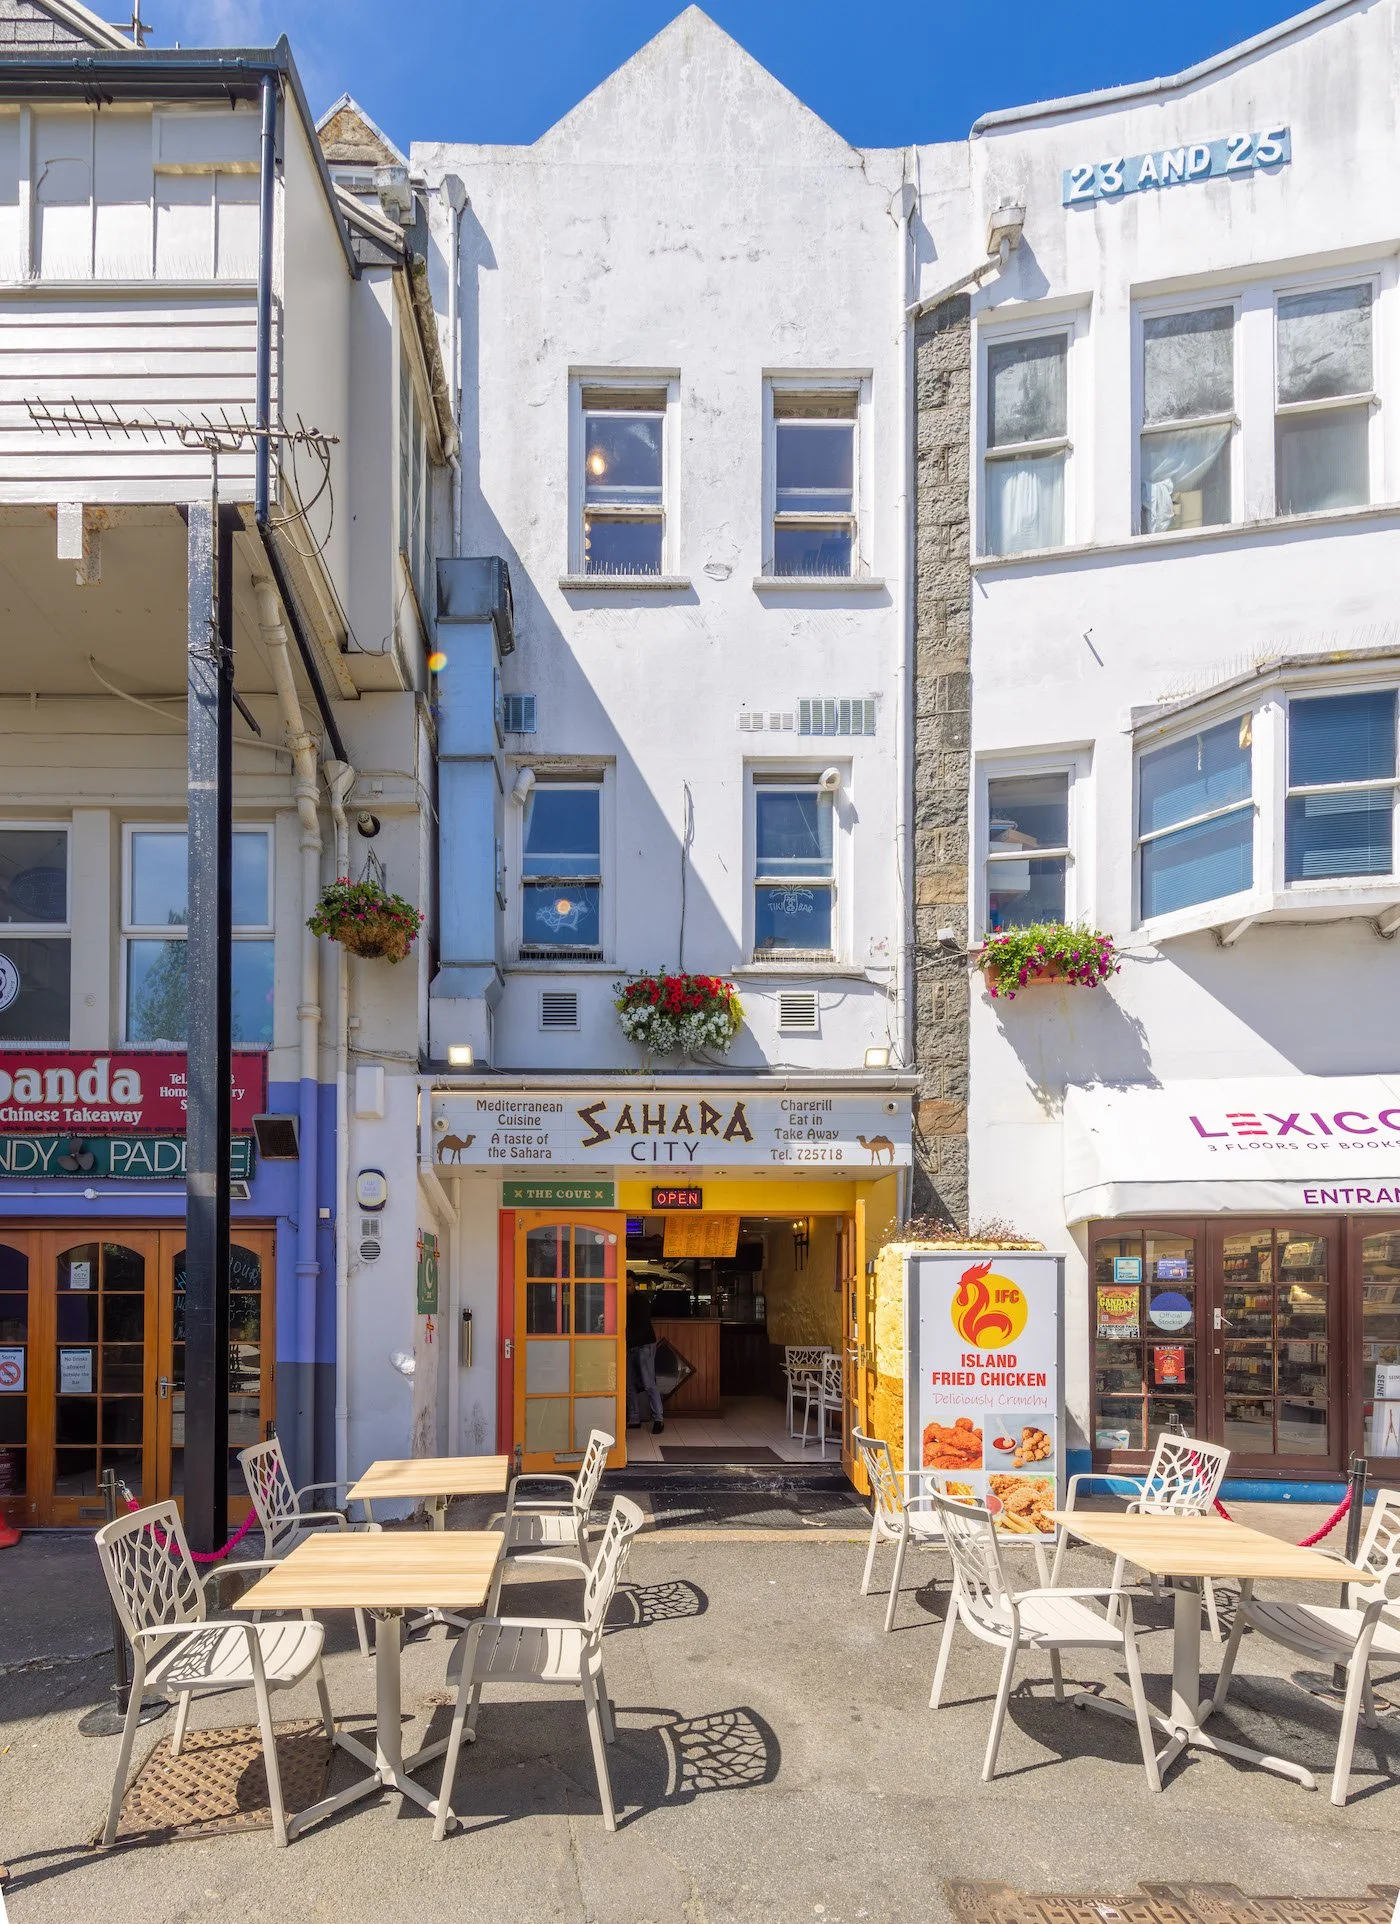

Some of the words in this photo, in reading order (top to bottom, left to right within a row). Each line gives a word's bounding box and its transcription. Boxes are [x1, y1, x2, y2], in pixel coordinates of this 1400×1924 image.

[1070, 155, 1125, 200] 23
[1137, 144, 1211, 187] AND
[1226, 126, 1287, 172] 25
[476, 1099, 563, 1112] Mediterranean
[780, 1099, 832, 1111] Chargrill
[0, 1107, 60, 1122] Chinese
[63, 1107, 143, 1126] Takeaway
[498, 1113, 541, 1126] Cuisine
[789, 1113, 808, 1126] Eat
[812, 1113, 823, 1126] in
[576, 1100, 755, 1148] SAHARA
[491, 1132, 500, 1145] A
[504, 1133, 533, 1145] taste
[536, 1133, 549, 1145] of
[774, 1128, 803, 1140] Take
[807, 1128, 839, 1140] Away
[488, 1146, 507, 1158] the
[510, 1146, 552, 1159] Sahara
[630, 1141, 700, 1162] CITY
[1207, 1144, 1218, 1152] 3
[1225, 1142, 1299, 1151] FLOORS
[1306, 1142, 1331, 1151] OF
[770, 1148, 792, 1161] Tel.
[797, 1148, 843, 1161] 725718
[526, 1189, 553, 1199] THE
[556, 1189, 591, 1199] COVE
[657, 1192, 698, 1205] OPEN
[994, 1289, 1020, 1304] IFC
[961, 1353, 1018, 1368] ISLAND
[932, 1372, 976, 1386] FRIED
[980, 1372, 1047, 1387] CHICKEN
[1376, 1374, 1385, 1397] SEINE
[932, 1392, 994, 1407] Deliciously
[998, 1393, 1048, 1408] Crunchy
